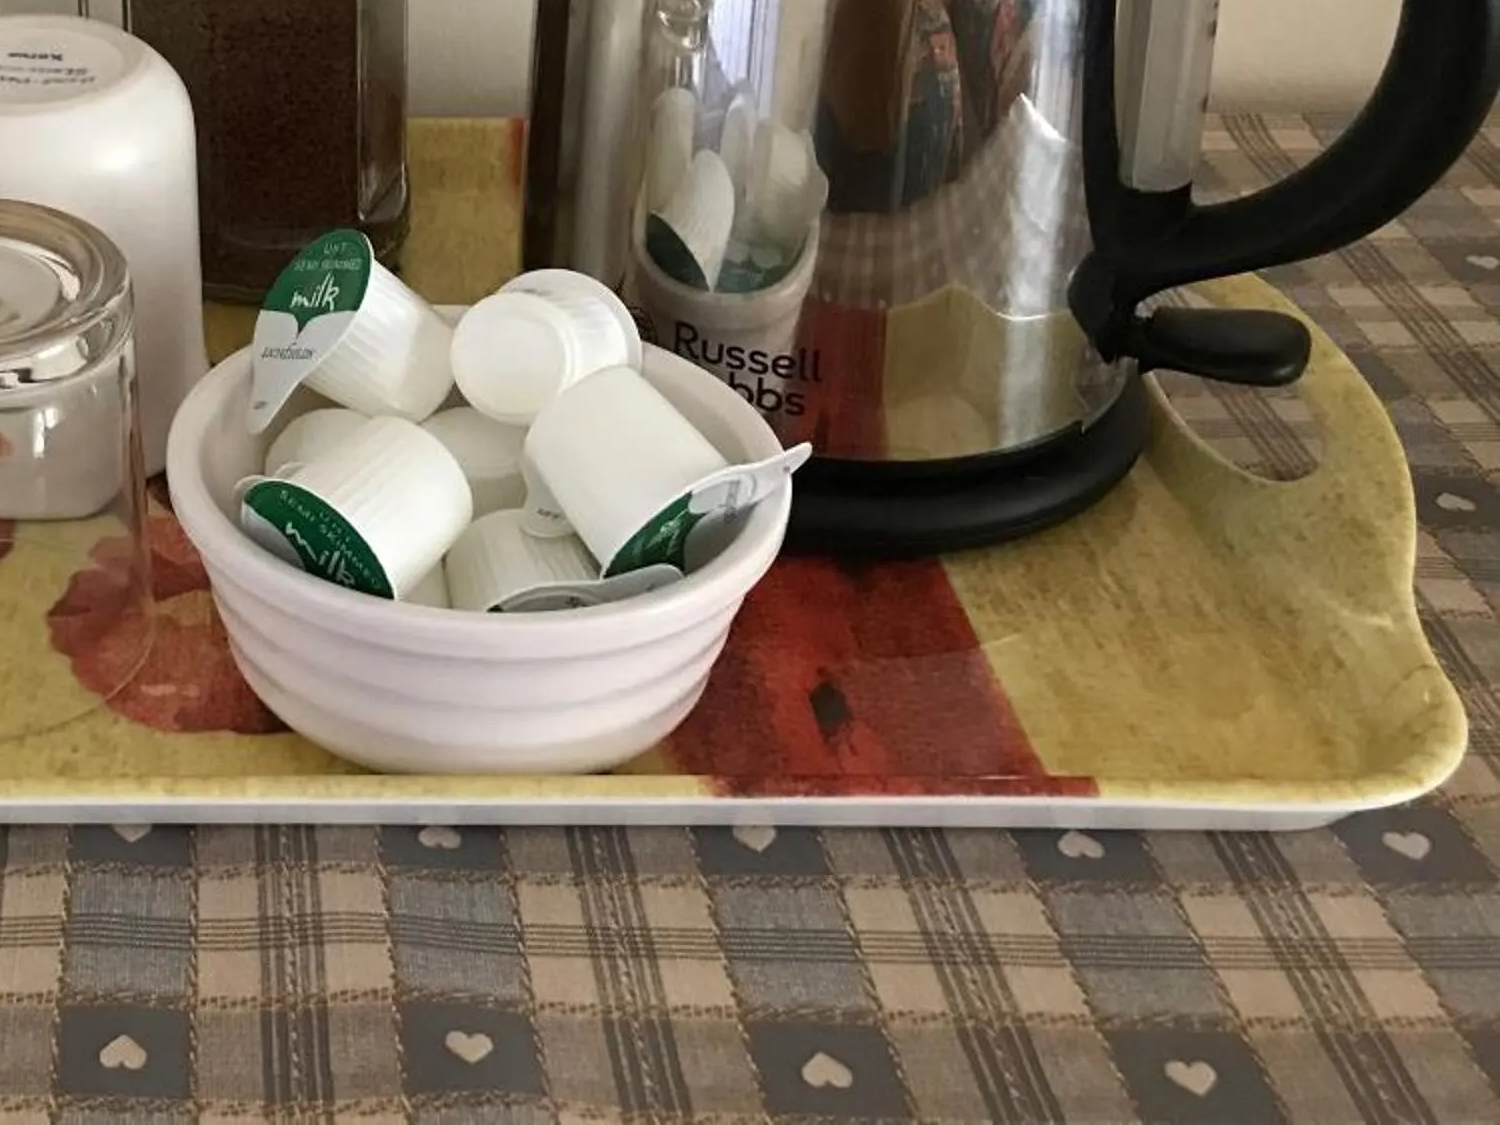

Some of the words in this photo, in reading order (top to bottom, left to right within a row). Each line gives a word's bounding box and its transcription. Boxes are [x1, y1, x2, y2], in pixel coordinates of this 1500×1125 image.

[290, 272, 340, 311] milk
[674, 321, 822, 383] Russell
[729, 372, 806, 417] bbs
